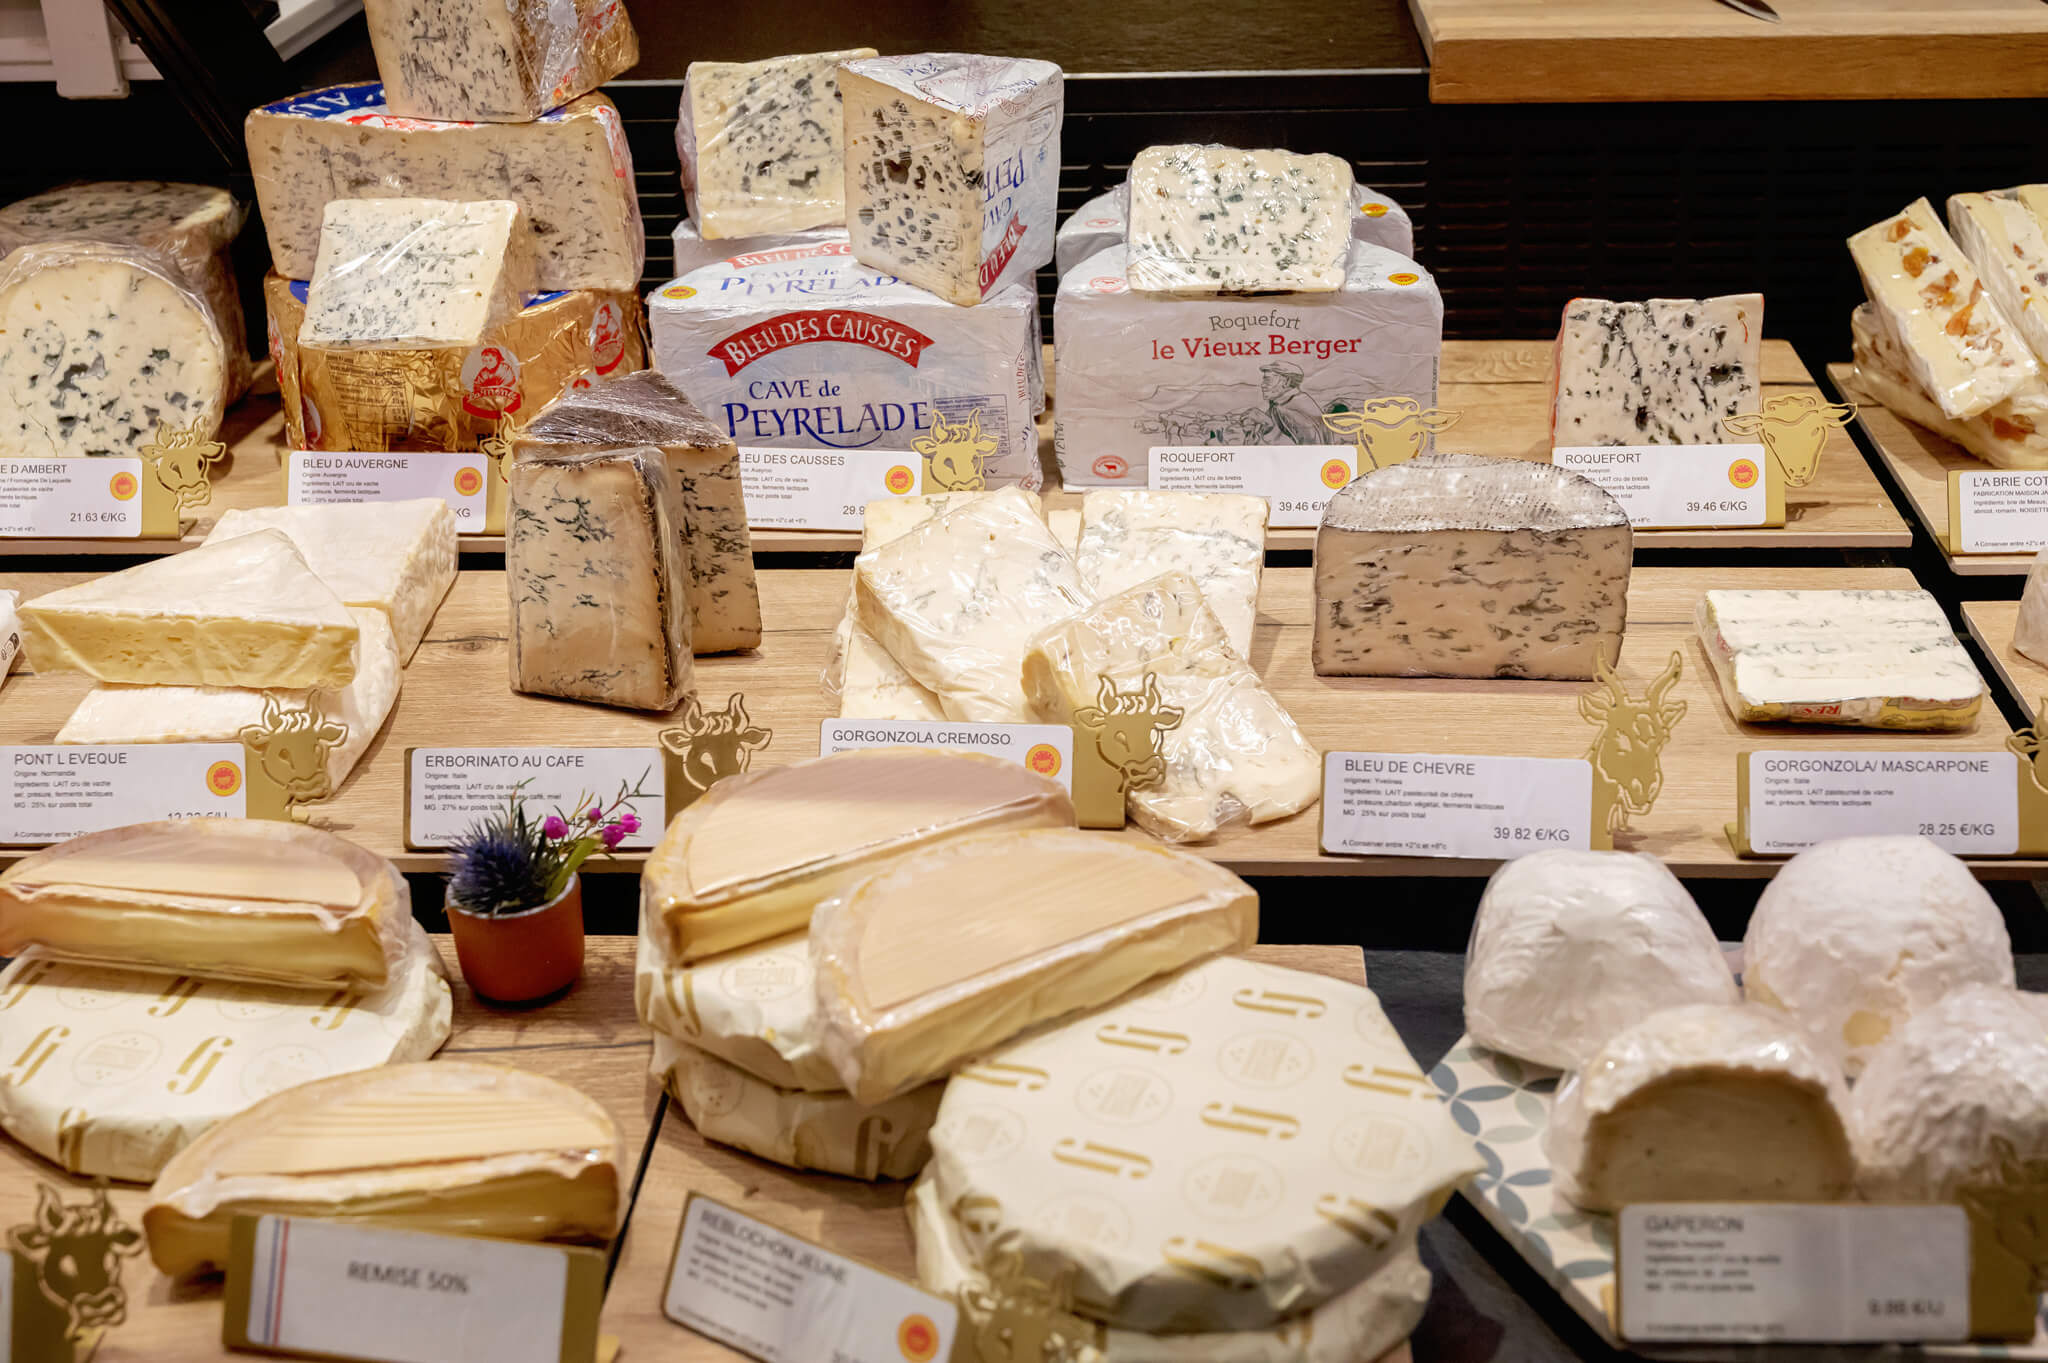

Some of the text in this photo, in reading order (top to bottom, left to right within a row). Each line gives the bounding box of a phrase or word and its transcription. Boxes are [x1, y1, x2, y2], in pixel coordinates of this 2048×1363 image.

[1208, 309, 1302, 332] Roquefort
[724, 313, 918, 367] BLEU DES CAUSSES
[1151, 333, 1362, 360] le Vieux Berger
[749, 379, 841, 401] CAVE de
[721, 401, 932, 447] PEYRELADE
[303, 459, 409, 469] BLEU D AUVERGNE
[764, 454, 788, 464] DES
[790, 455, 845, 466] CAUSSES
[1160, 452, 1235, 463] ROQUEFORT
[1565, 453, 1642, 464] ROQUEFORT
[11, 464, 67, 474] D AMBERT
[1973, 477, 1991, 488] L'A
[1992, 477, 2021, 487] BRIE
[843, 506, 865, 516] 29.9
[1279, 502, 1309, 512] 39.46
[1687, 501, 1748, 512] 39.46 €/KG
[70, 512, 127, 523] 21.63 €/KG
[832, 729, 1011, 745] GORGONZOLA CREMOSO
[14, 753, 128, 765] PONT L EVEQUE
[425, 755, 584, 768] ERBORINATO AU CAFE
[1344, 760, 1476, 775] BLEU DE CHEVRE
[1764, 760, 1989, 773] GORGONZOLA/ MASCARPONE
[1493, 827, 1570, 842] 39.82 €/KG
[1918, 824, 1996, 837] 28.25 €/KG
[1644, 1215, 1745, 1233] GAPERON
[700, 1209, 795, 1260] REBLOCHON
[347, 1261, 470, 1295] REMISE 50%
